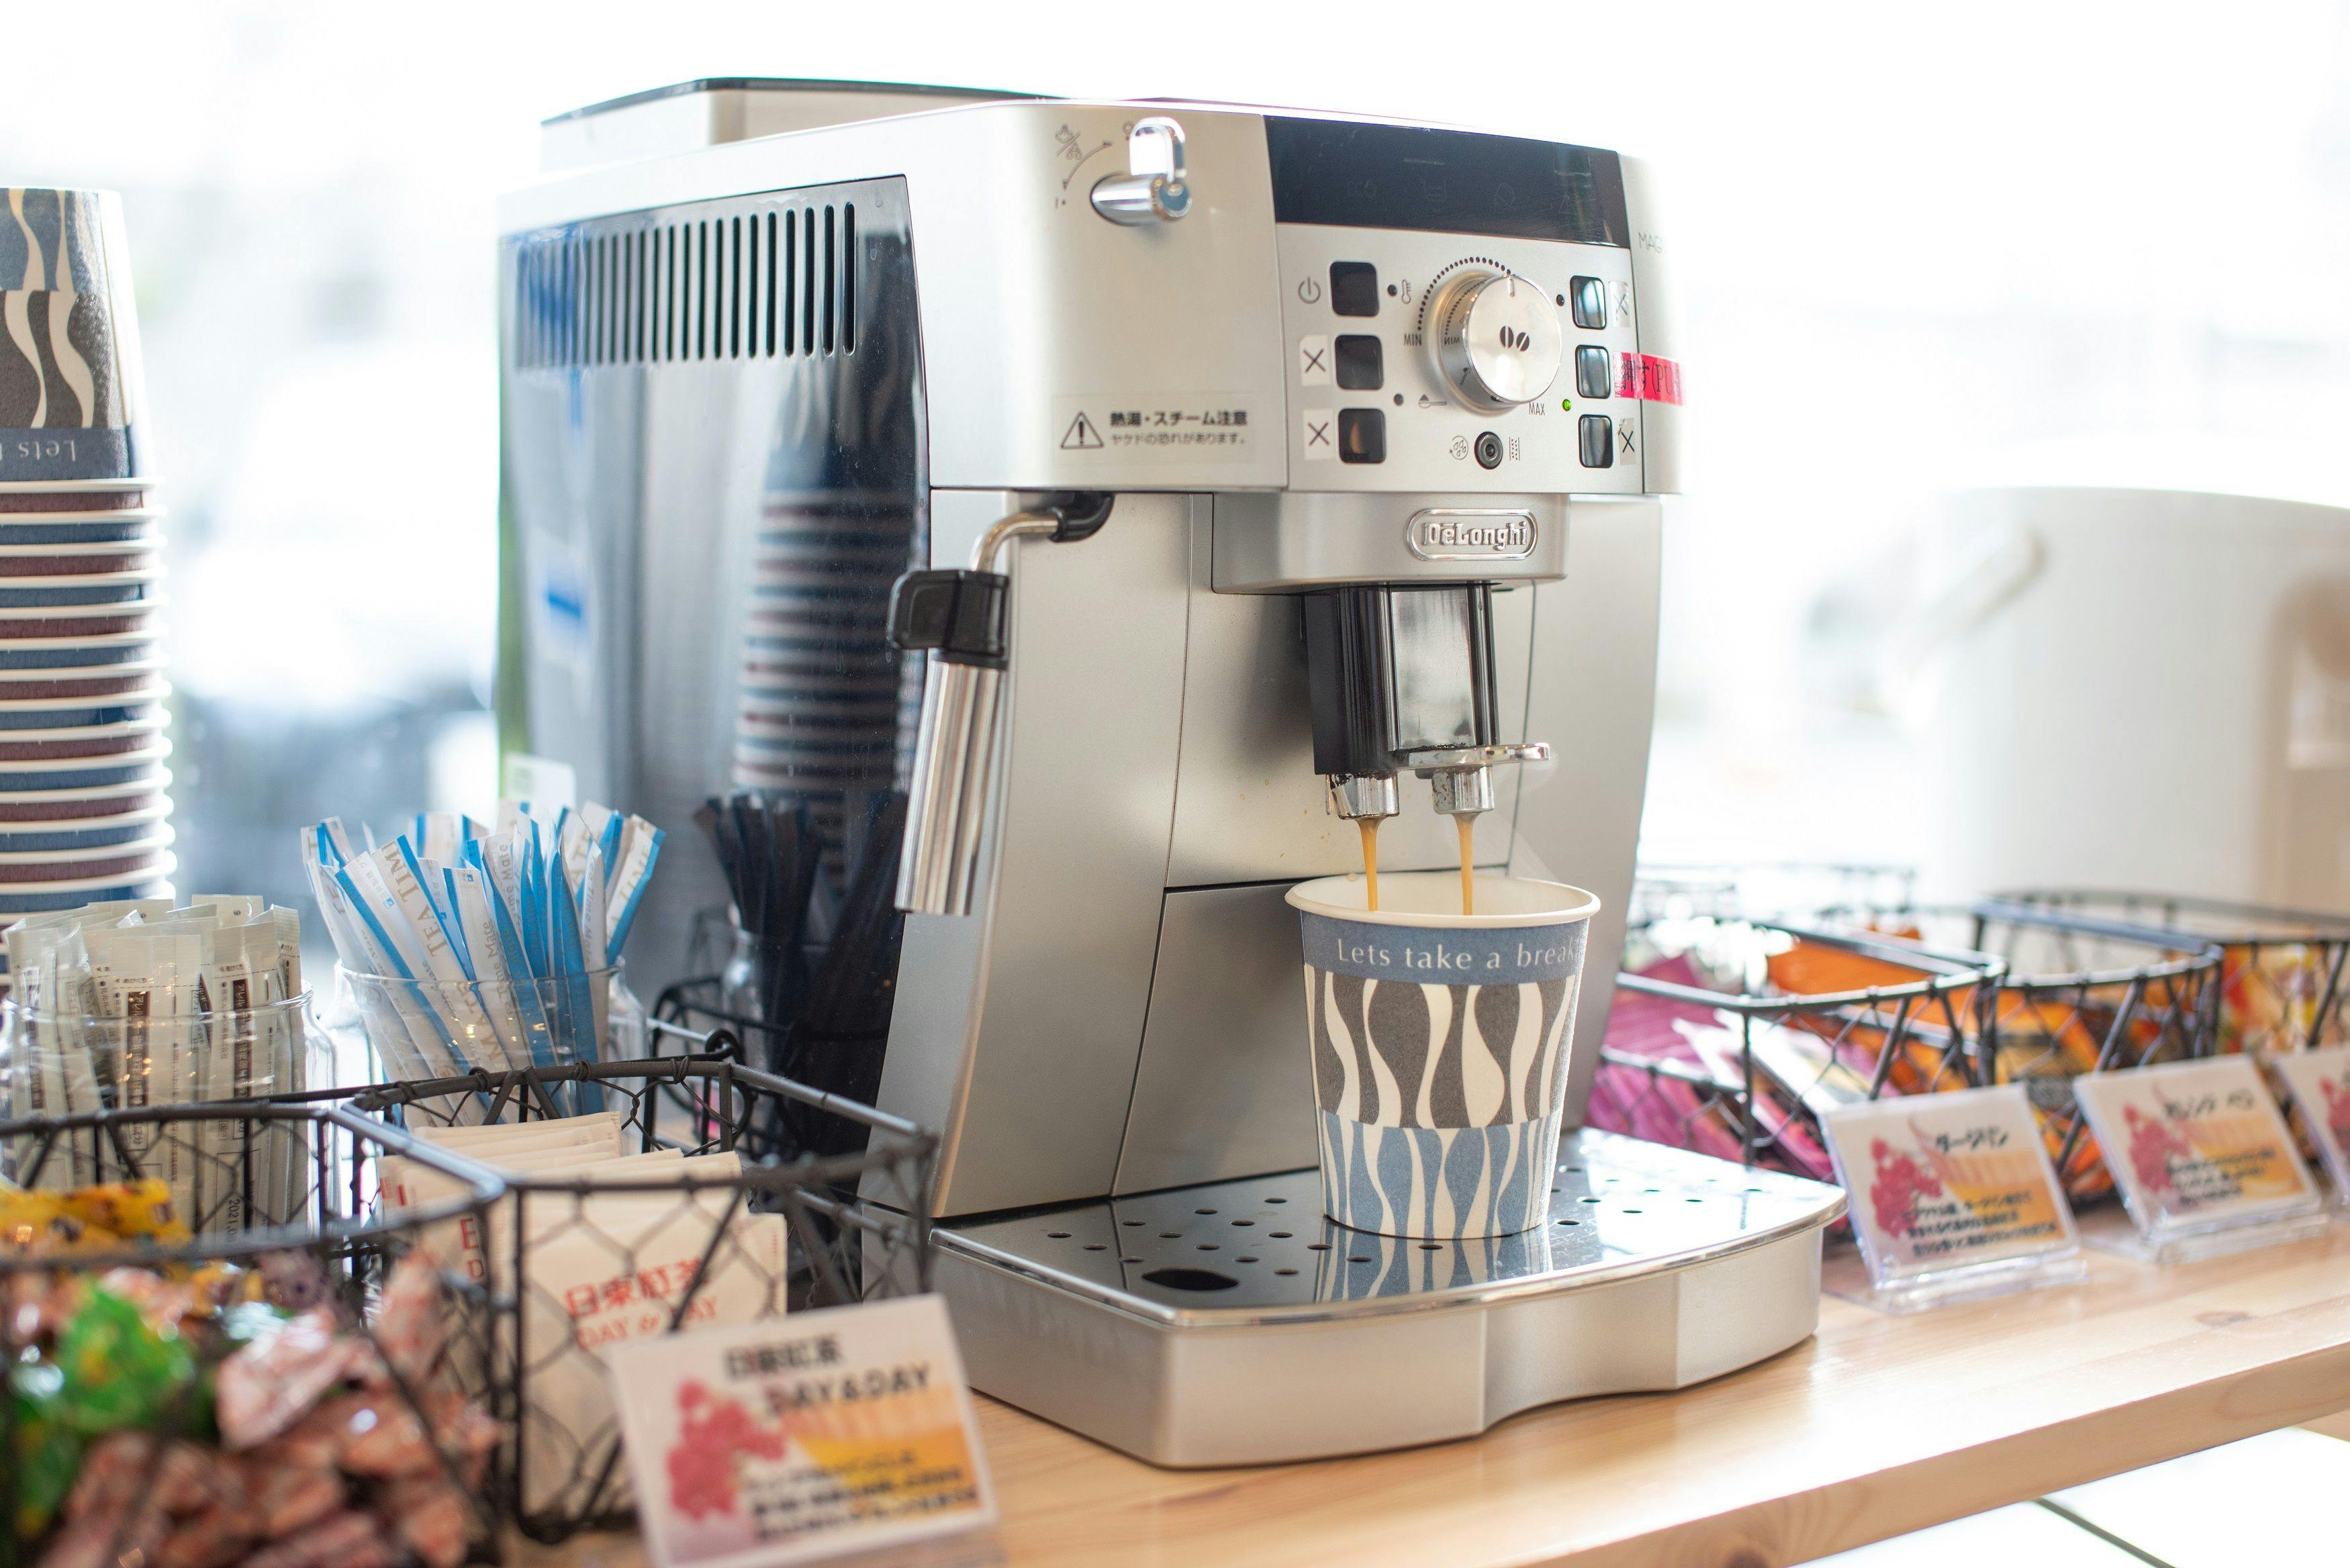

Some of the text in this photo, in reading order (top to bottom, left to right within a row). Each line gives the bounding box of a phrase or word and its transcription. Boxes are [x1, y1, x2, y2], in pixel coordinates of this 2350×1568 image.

[1403, 333, 1422, 346] MIN
[1111, 410, 1247, 427] 熱湯・スチーム注意
[1529, 401, 1545, 415] MAX
[418, 904, 450, 957] TEA
[483, 920, 498, 959] Mate
[1337, 938, 1391, 966] Lets
[1406, 943, 1472, 971] take
[1486, 952, 1501, 969] a
